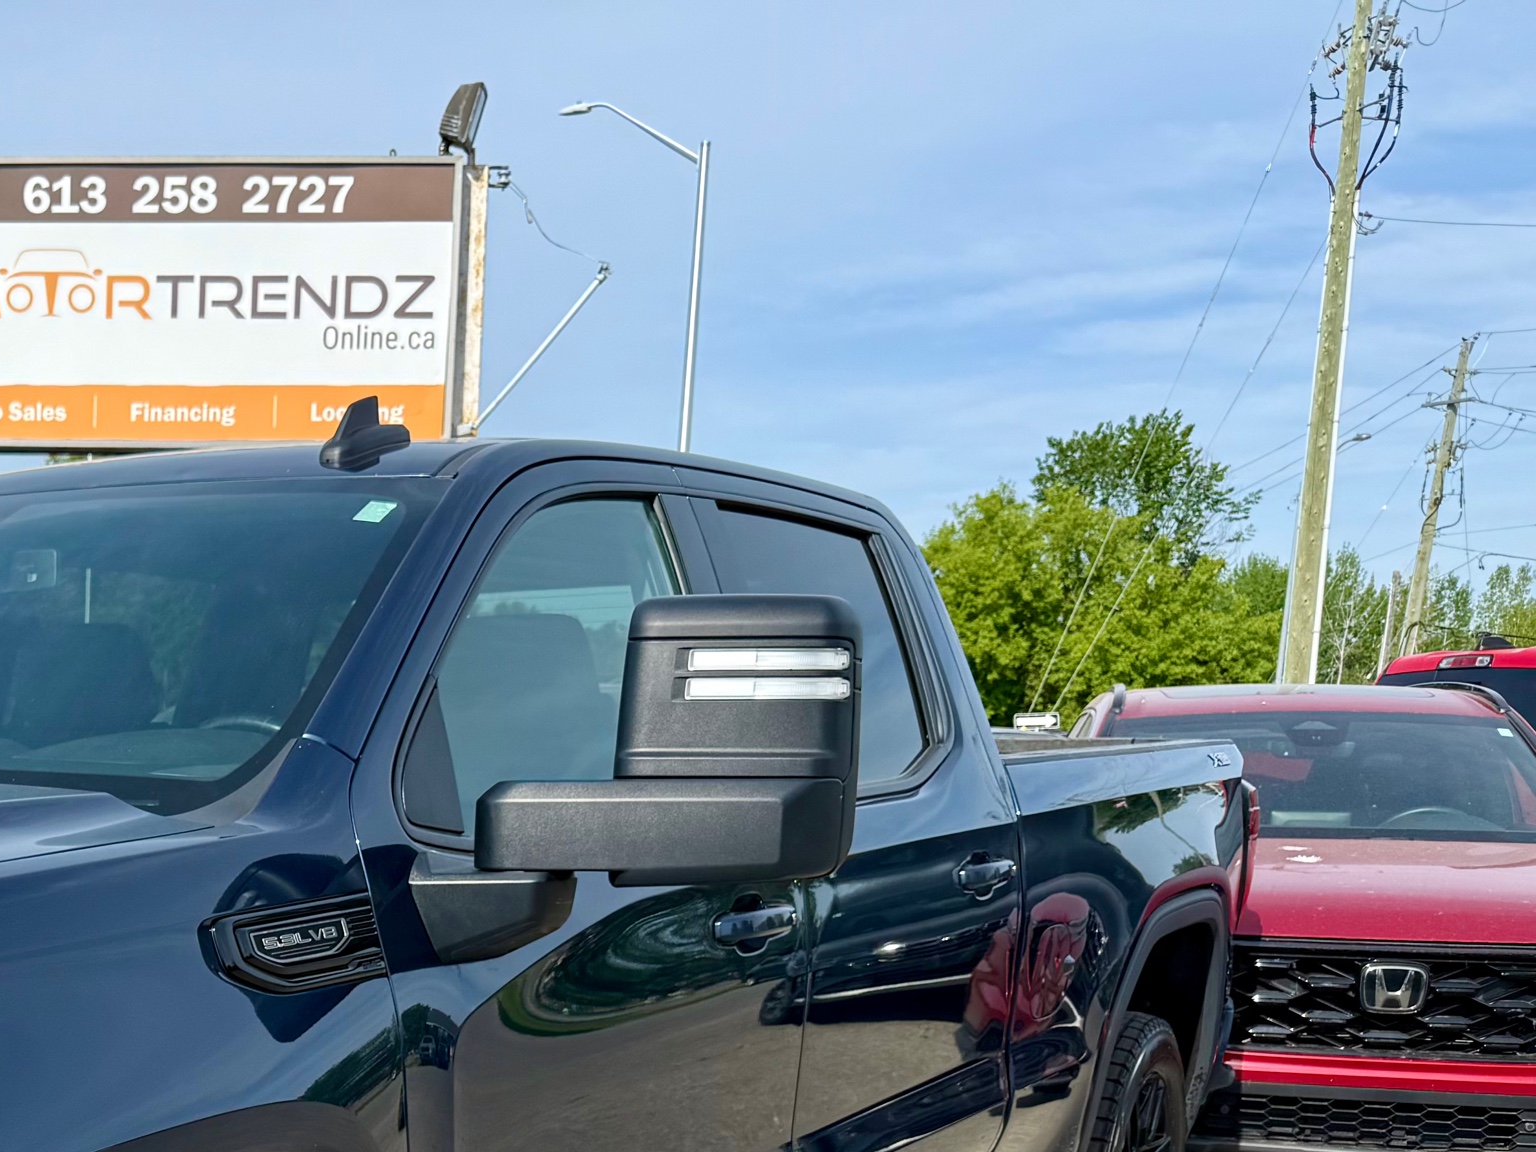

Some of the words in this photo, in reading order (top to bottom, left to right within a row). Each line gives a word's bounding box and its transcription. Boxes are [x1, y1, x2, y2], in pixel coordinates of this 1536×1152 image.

[22, 175, 107, 214] 613
[131, 175, 218, 214] 258
[241, 175, 355, 214] 2727
[322, 325, 436, 350] Online.ca
[7, 401, 67, 421] Sales
[129, 402, 236, 426] Financing
